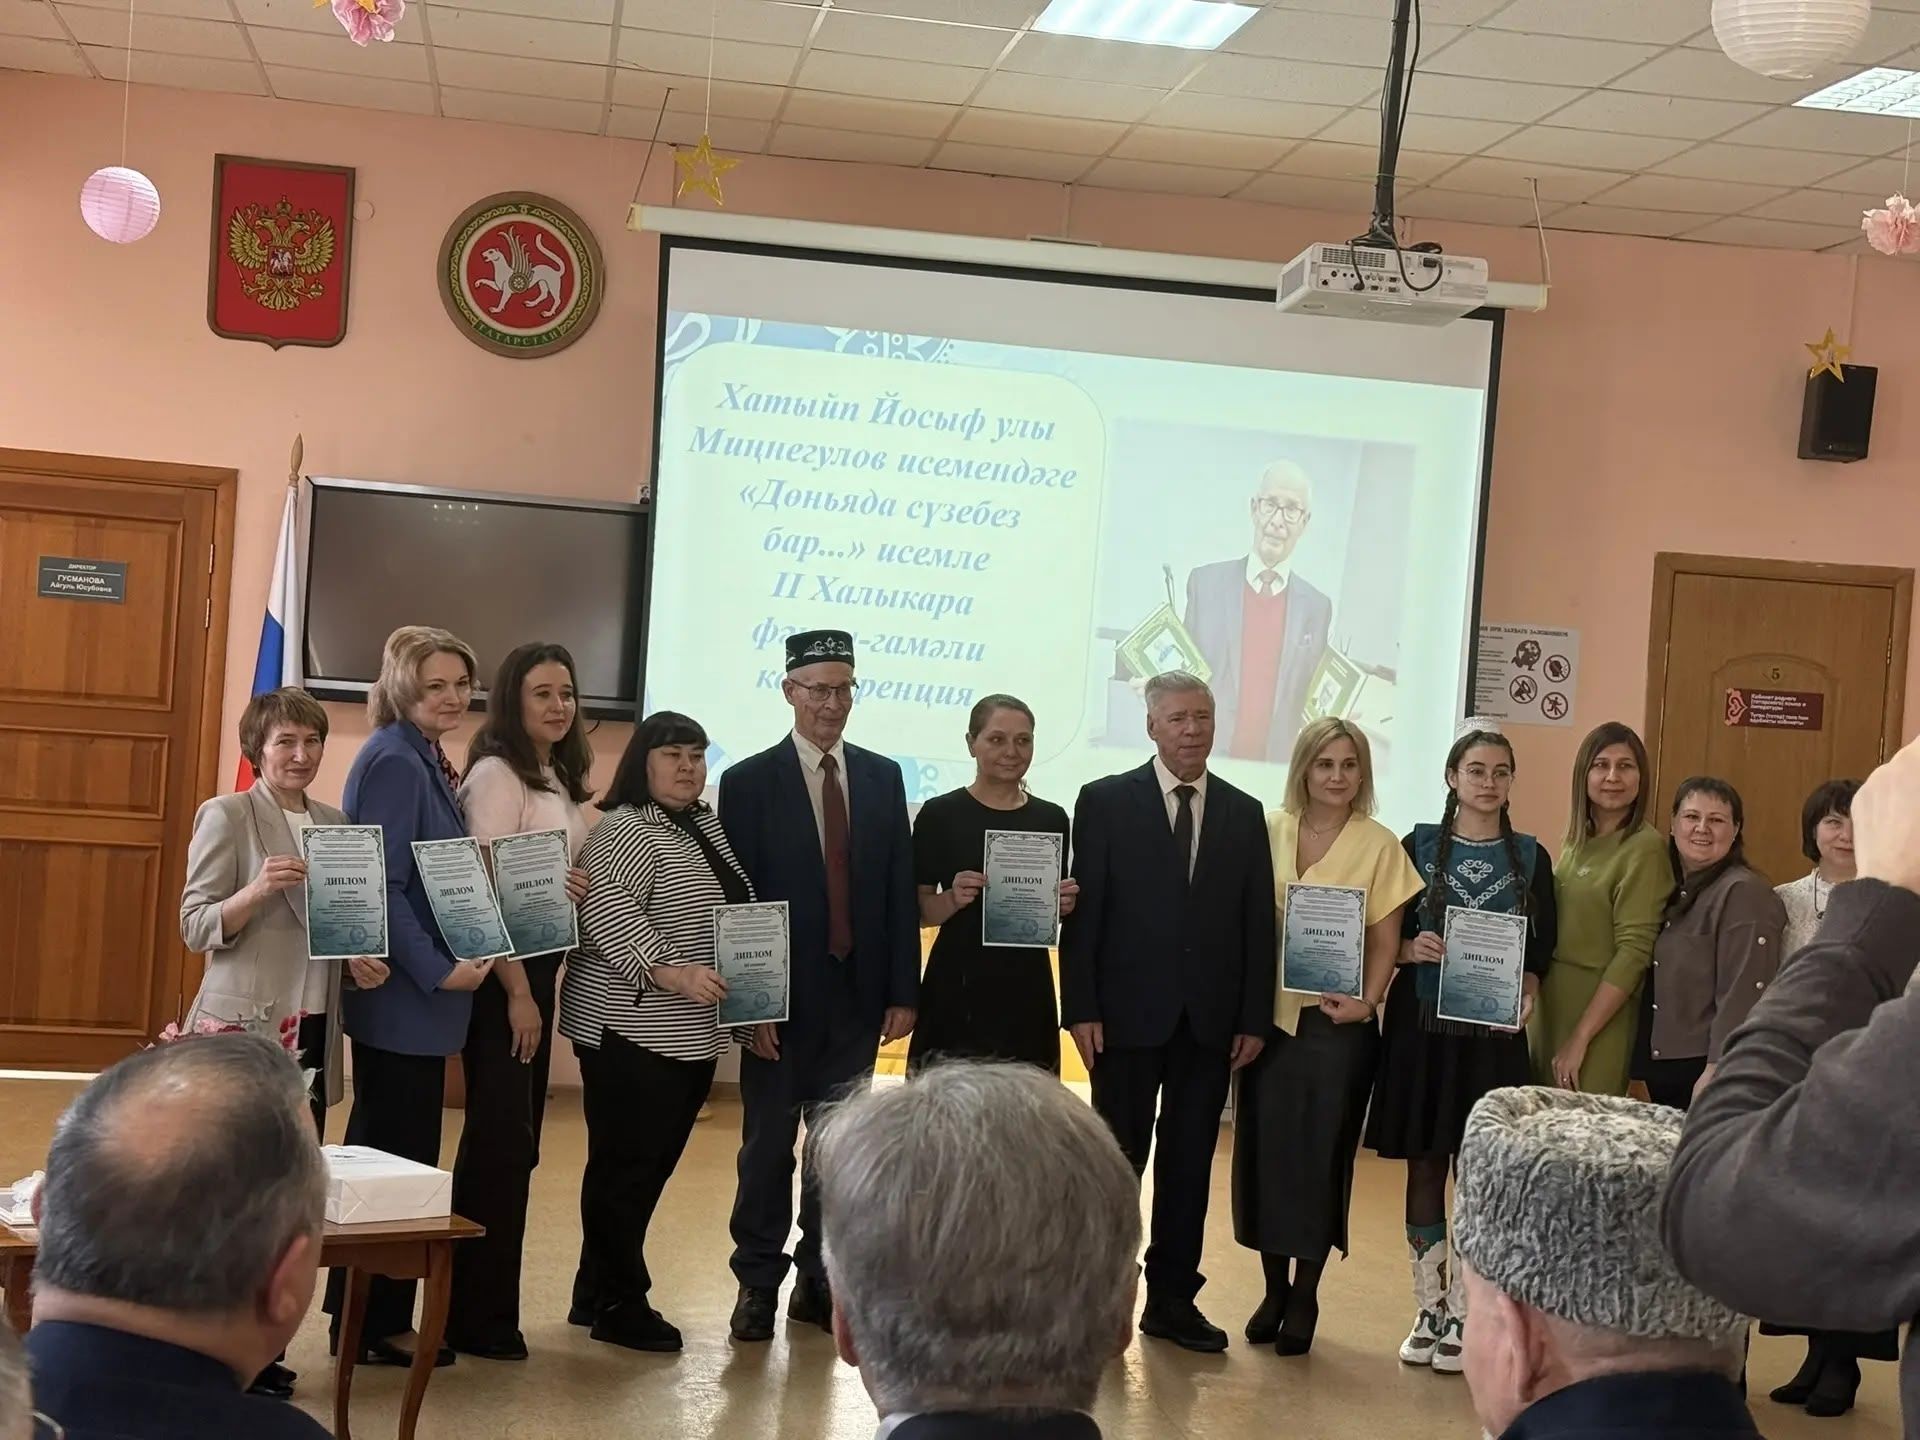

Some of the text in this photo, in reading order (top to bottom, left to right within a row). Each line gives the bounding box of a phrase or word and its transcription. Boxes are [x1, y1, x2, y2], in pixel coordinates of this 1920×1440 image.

[479, 324, 558, 346] ТАТАРСТАН
[715, 382, 1056, 443] Хатыйп Йосыф улы
[688, 425, 1077, 488] Миңнегулов исемендәге
[740, 479, 1021, 528] «Дөньяда сүзебез
[763, 526, 991, 571] бар...» исемле
[68, 563, 97, 571] ДИРЕКТОР
[57, 574, 105, 585] ГУСМАНОВА
[50, 581, 113, 594] Айгуль Юсубовна
[808, 574, 974, 621] Халыкара
[1771, 668, 1780, 680] 5
[324, 876, 367, 886] ДИПЛОМ
[513, 877, 554, 892] ДИПЛОМ
[1001, 875, 1043, 885] ДИПЛОМ
[439, 885, 475, 898] ДИПЛОМ
[1302, 927, 1345, 938] ДИПЛОМ
[733, 950, 773, 961] ДИПЛОМ
[1460, 951, 1504, 965] ДИПЛОМ
